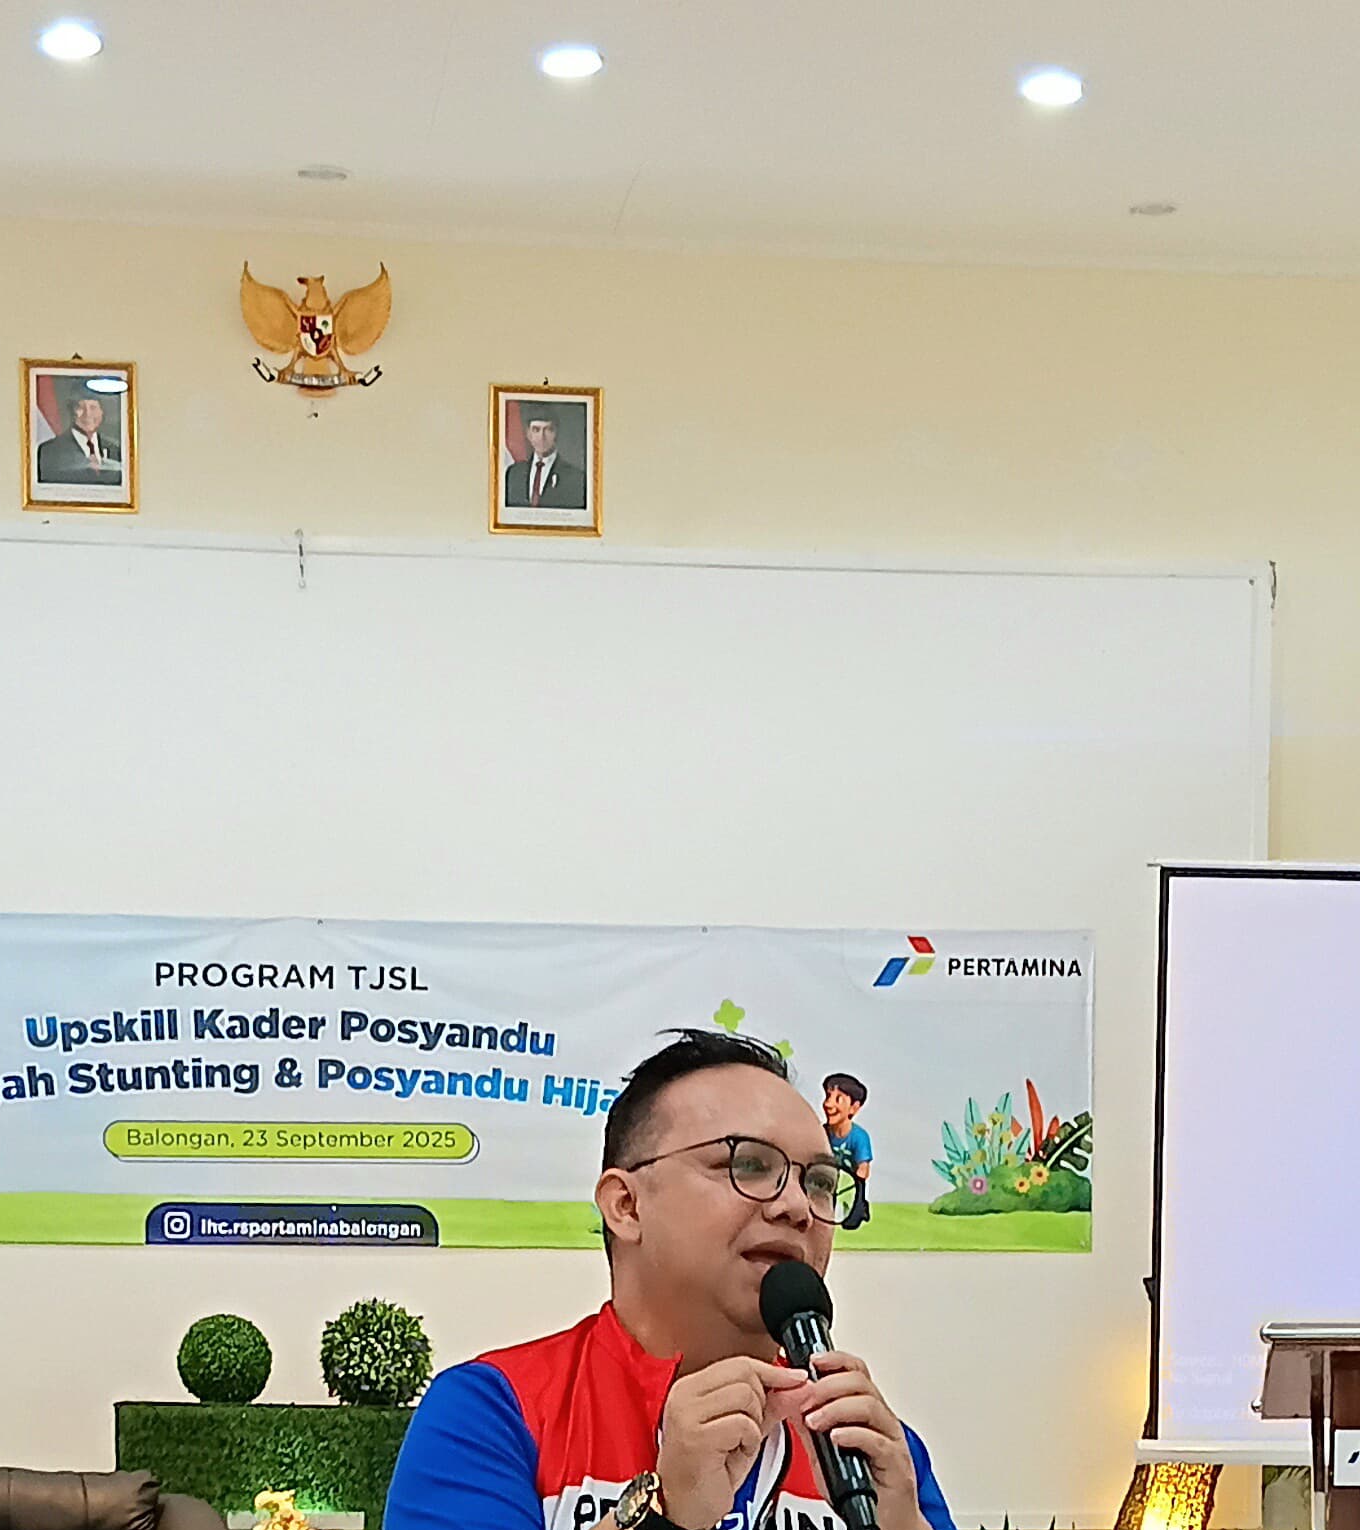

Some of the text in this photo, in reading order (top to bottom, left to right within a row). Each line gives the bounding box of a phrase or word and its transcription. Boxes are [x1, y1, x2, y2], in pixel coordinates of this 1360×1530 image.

[155, 962, 429, 991] PROGRAM TJSL
[948, 957, 1082, 977] PERTAMINA
[25, 1008, 556, 1057] Upskill Kader Posyandu
[68, 1057, 260, 1094] Stunting
[274, 1057, 303, 1089] &
[318, 1058, 529, 1102] Posyandu
[543, 1074, 620, 1116] Hija
[127, 1128, 457, 1150] Balongan, 23 September 2025
